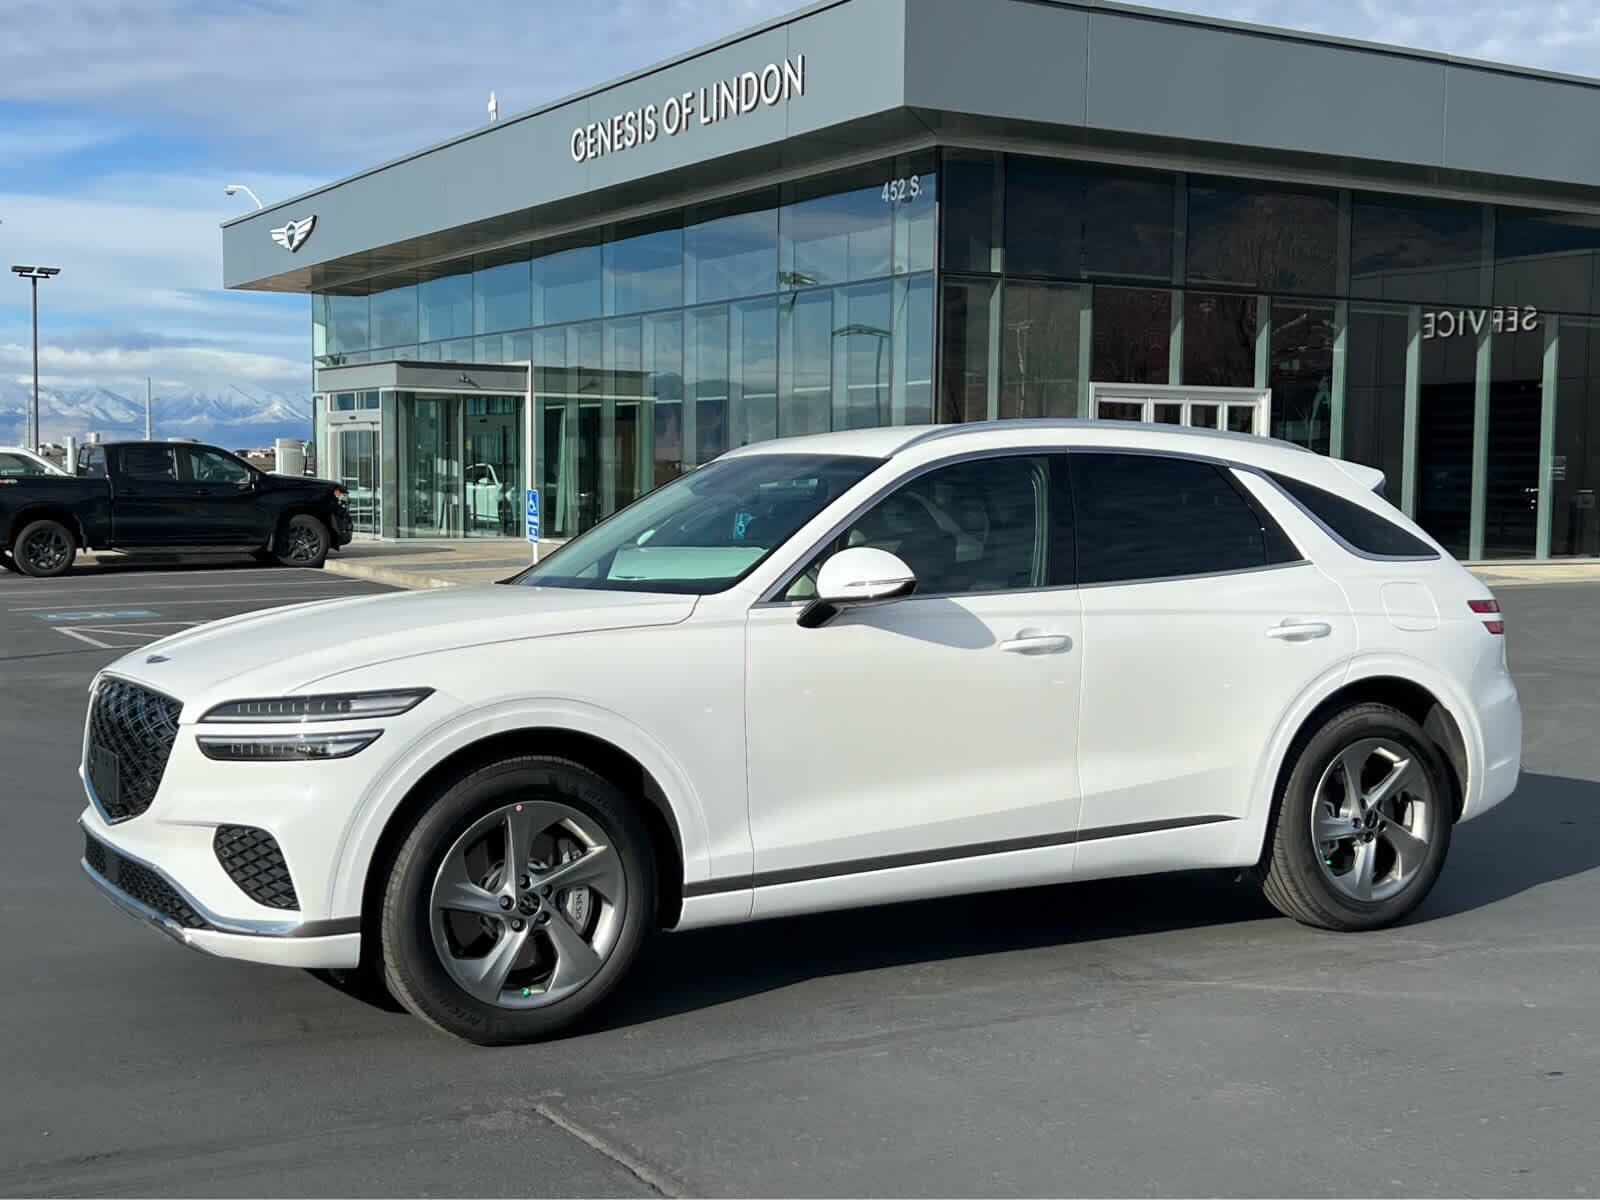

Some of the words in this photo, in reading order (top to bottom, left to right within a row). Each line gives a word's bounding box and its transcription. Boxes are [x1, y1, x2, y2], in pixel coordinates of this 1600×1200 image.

[571, 104, 658, 163] GENESIS
[663, 91, 695, 136] OF
[700, 54, 805, 126] LINDON
[881, 178, 905, 203] 452
[910, 174, 923, 197] S.
